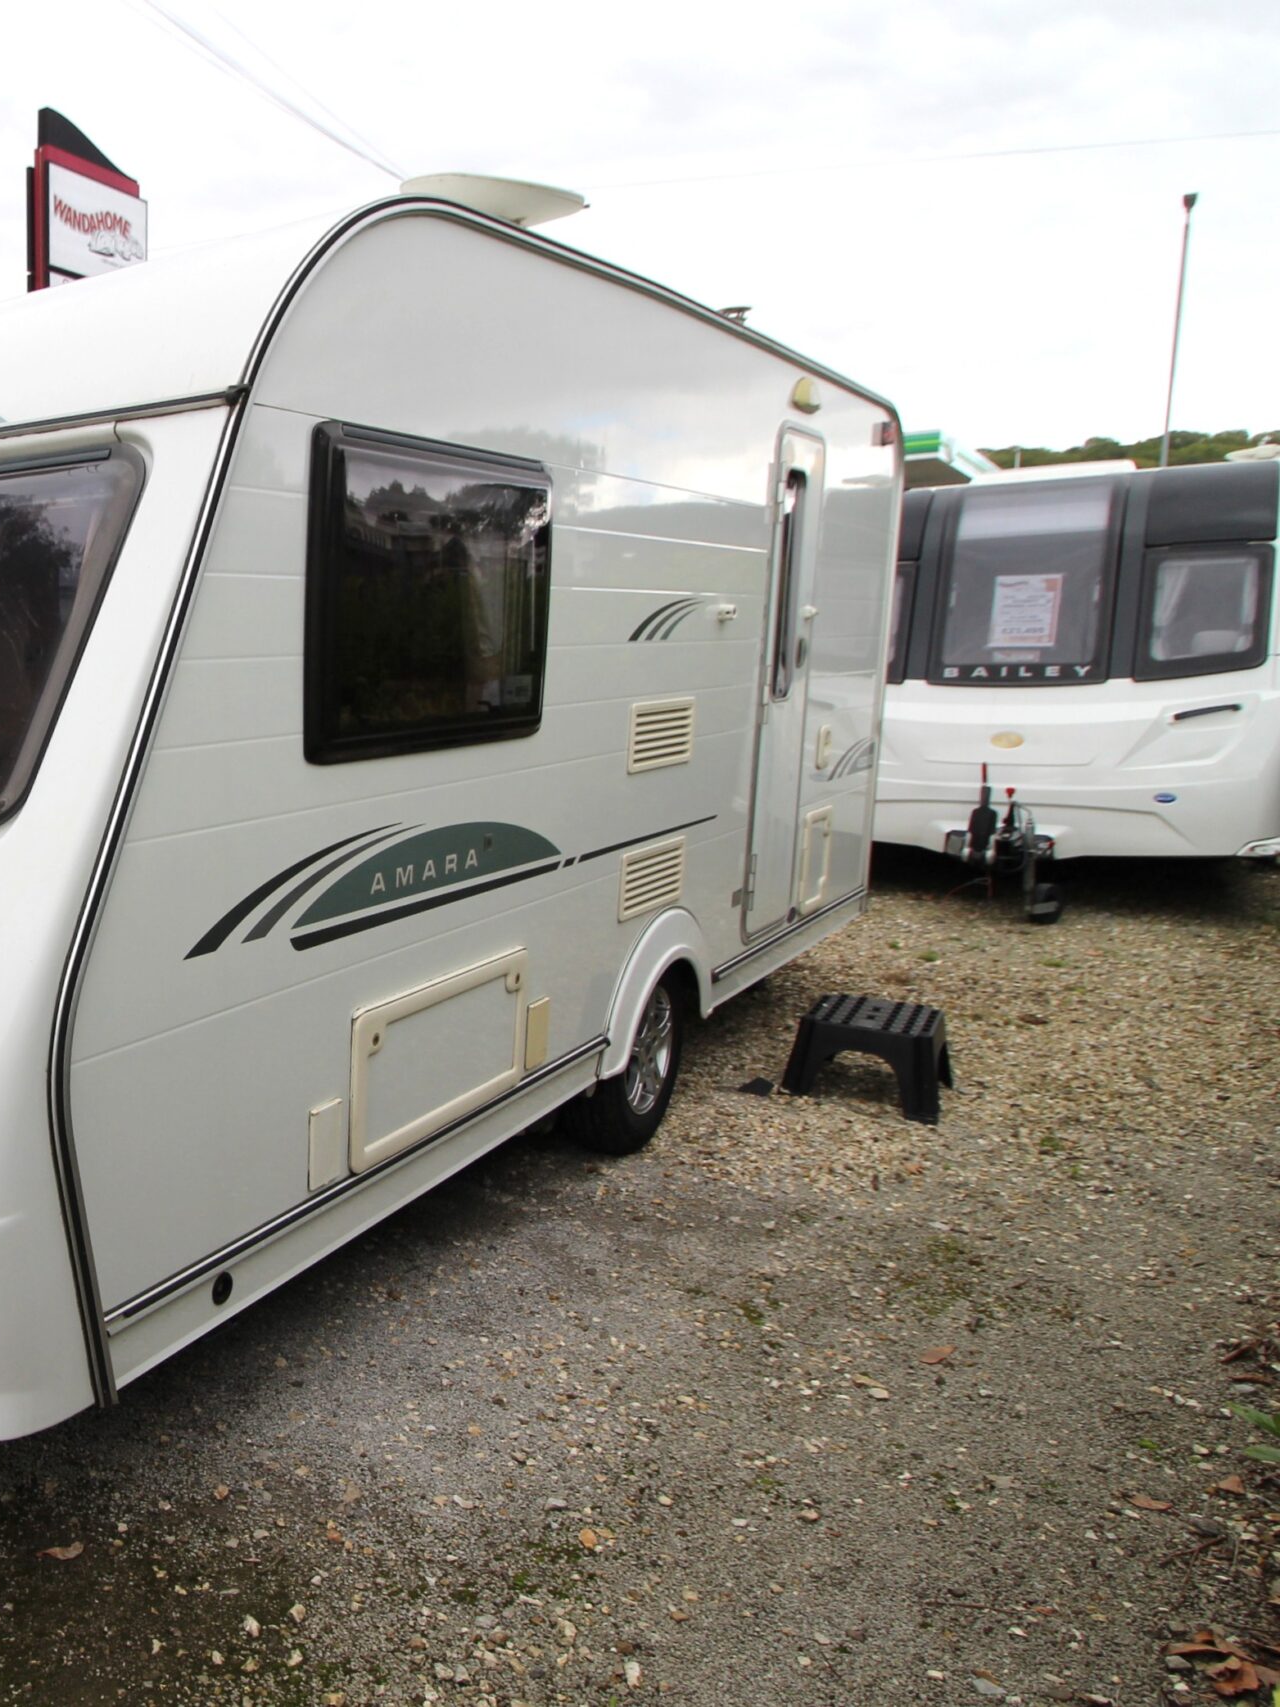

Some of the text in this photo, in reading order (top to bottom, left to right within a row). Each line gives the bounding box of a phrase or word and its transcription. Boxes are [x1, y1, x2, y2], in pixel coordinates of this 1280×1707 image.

[53, 194, 131, 238] WANDAHOME
[943, 665, 1091, 678] BAILEY
[370, 848, 479, 895] AMARA
